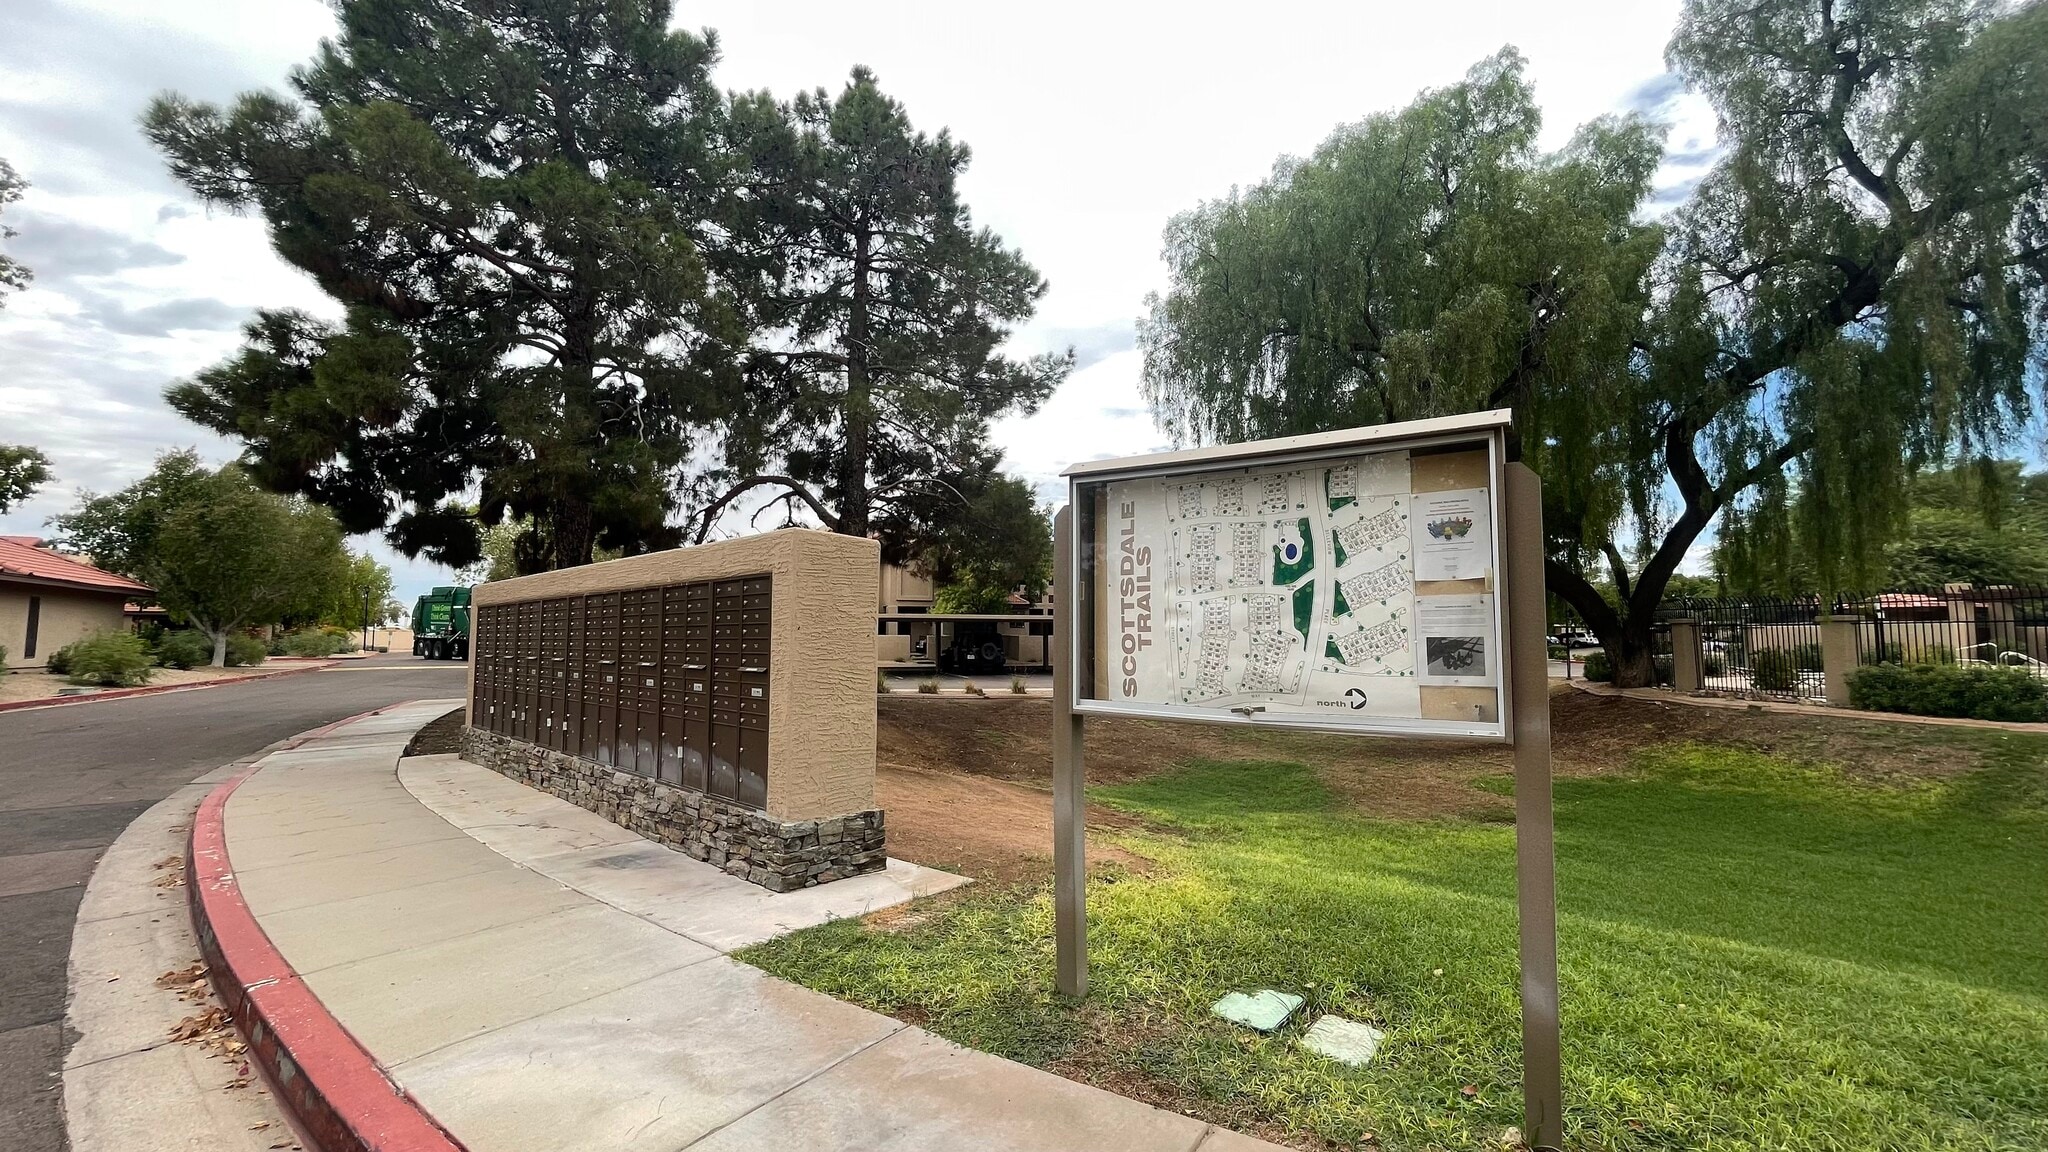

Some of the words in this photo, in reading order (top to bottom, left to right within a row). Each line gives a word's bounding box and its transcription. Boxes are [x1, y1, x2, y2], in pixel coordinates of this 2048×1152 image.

[1121, 501, 1137, 698] SCOTTSDALE
[1136, 545, 1152, 651] TRAILS
[1316, 700, 1347, 708] north
